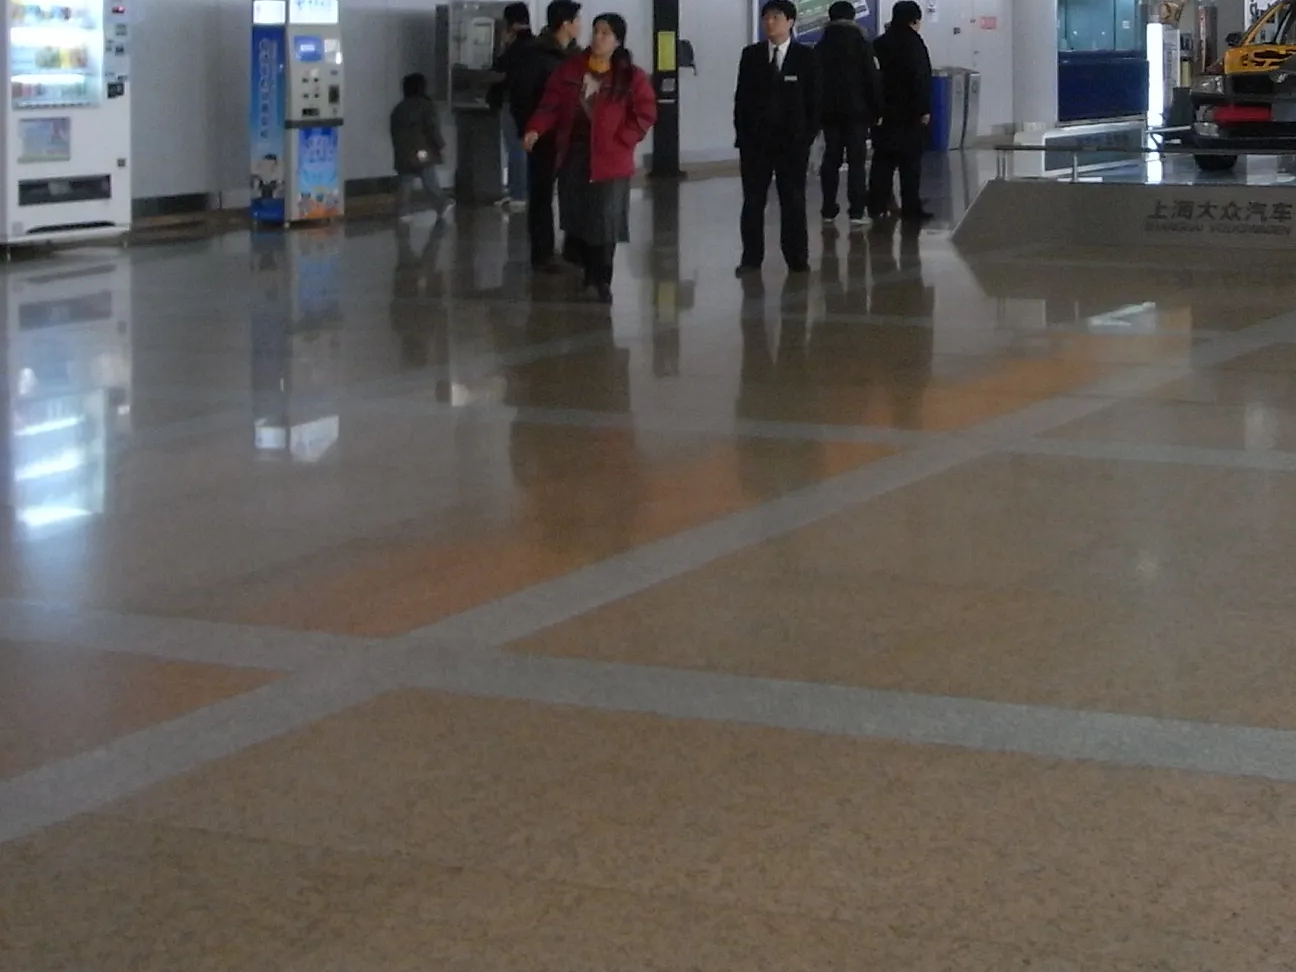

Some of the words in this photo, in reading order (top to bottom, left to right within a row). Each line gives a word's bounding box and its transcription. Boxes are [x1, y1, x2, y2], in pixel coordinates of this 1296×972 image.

[1147, 199, 1293, 223] 上海大众汽车
